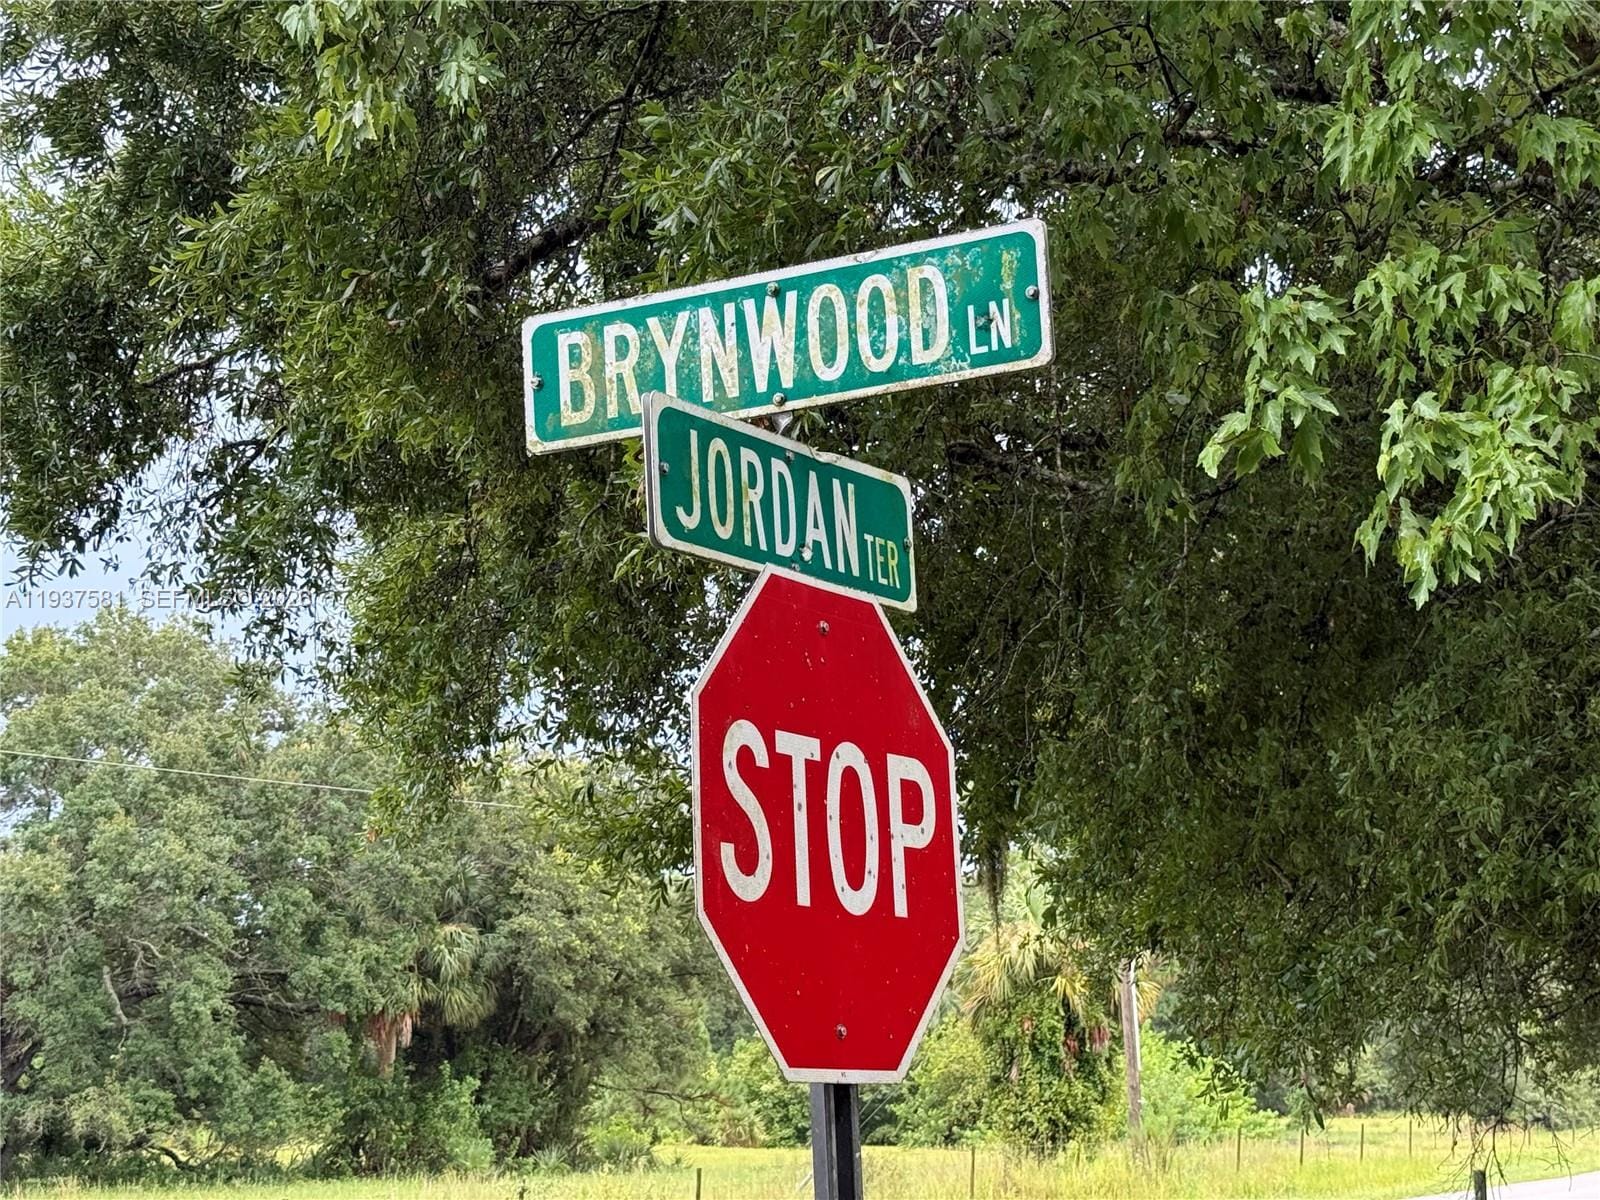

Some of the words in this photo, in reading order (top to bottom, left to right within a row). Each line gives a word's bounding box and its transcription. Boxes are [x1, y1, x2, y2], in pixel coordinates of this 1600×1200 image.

[557, 264, 950, 427] BRYNWOOD
[967, 297, 1013, 356] LN
[675, 428, 860, 578] JORDAN
[863, 532, 901, 589] TER
[720, 719, 936, 919] STOP
